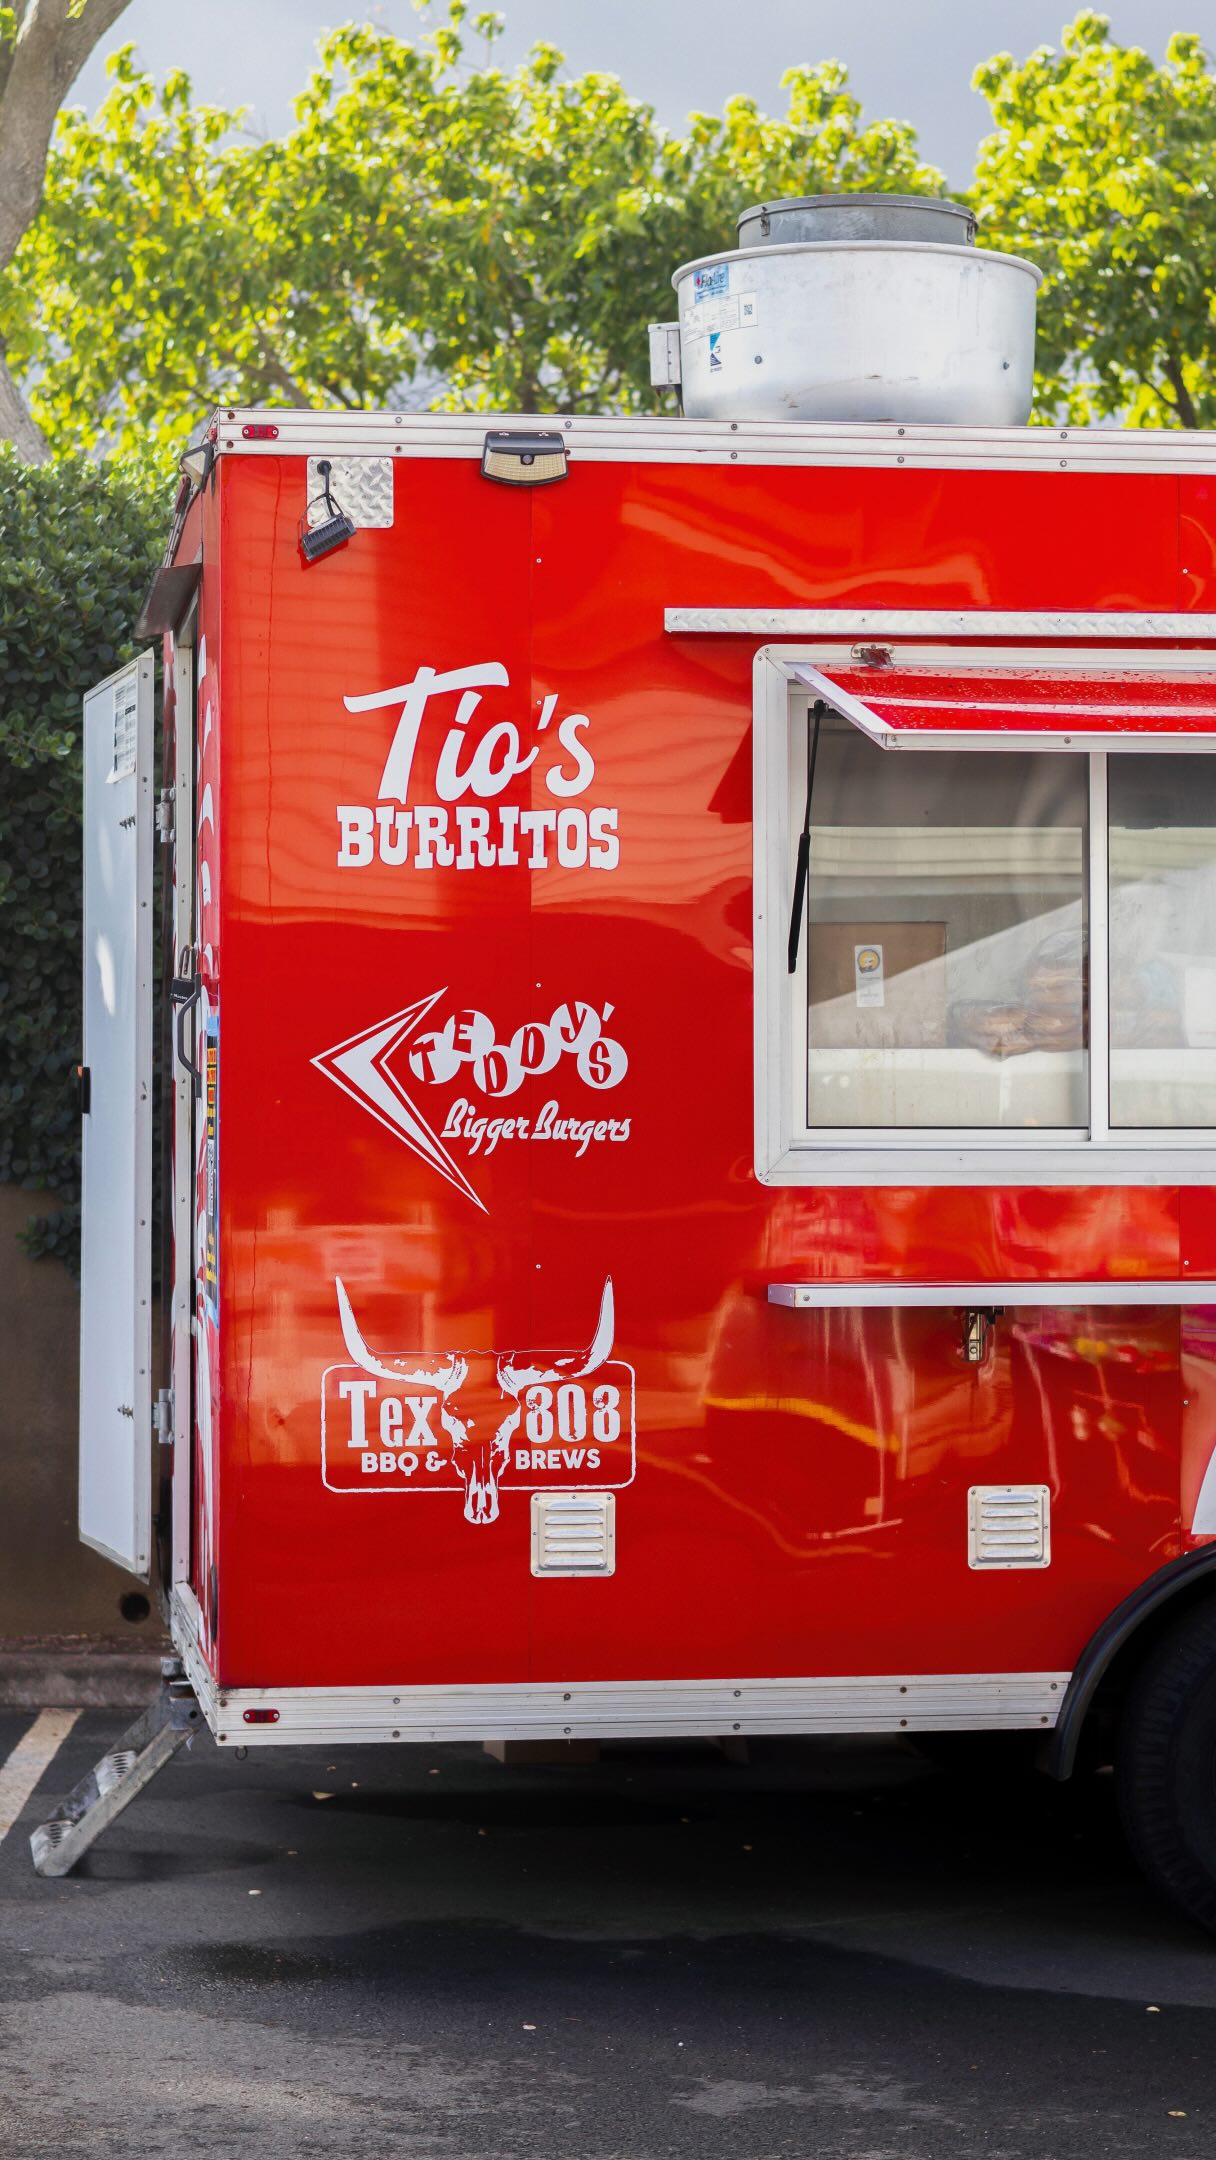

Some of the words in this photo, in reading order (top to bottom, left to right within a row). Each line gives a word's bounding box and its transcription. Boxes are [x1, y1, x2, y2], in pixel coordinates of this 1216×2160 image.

[343, 662, 595, 804] Tio's
[336, 805, 620, 870] BURRITOS
[409, 1001, 628, 1097] TEDDY'S
[440, 1097, 529, 1155] Bigger
[532, 1100, 632, 1157] Burgers
[339, 1380, 438, 1448] Tex
[526, 1384, 621, 1443] 808
[361, 1452, 419, 1476] BBQ
[426, 1451, 447, 1472] &
[515, 1449, 601, 1470] BREWS
